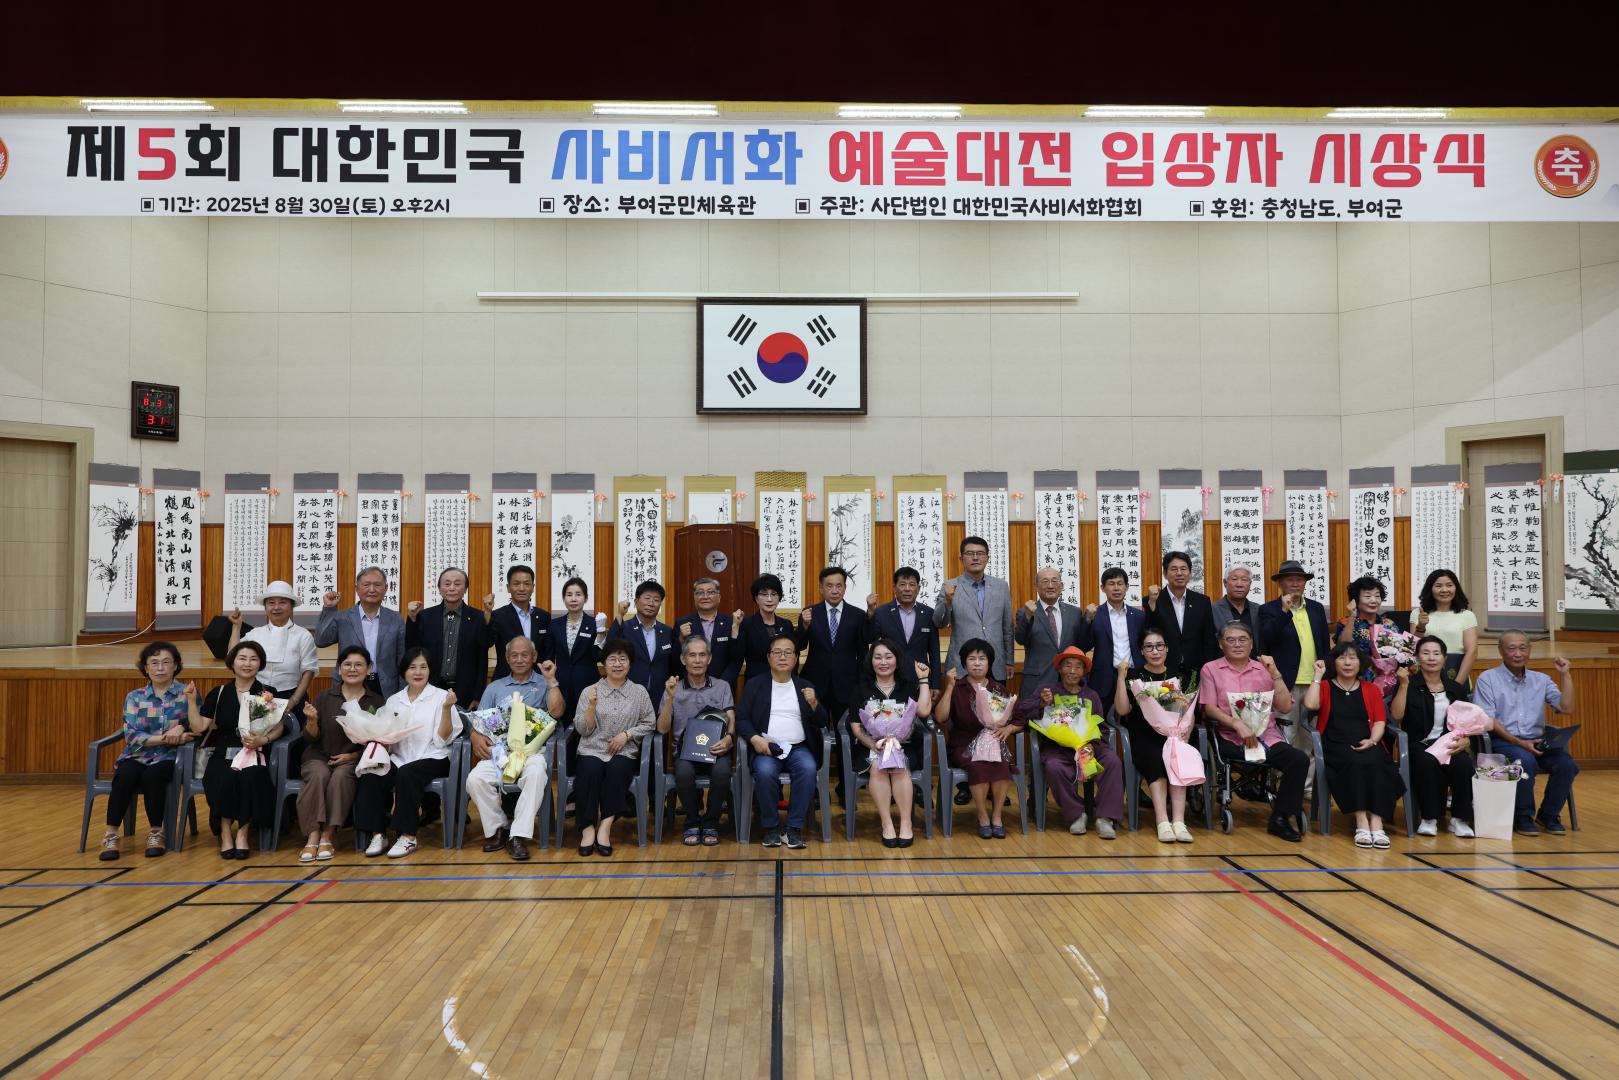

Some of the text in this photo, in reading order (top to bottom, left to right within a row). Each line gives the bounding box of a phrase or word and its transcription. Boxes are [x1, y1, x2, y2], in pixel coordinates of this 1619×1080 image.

[66, 123, 1486, 188] 제5회 대한민국 사비서화 예술대전 입상자 시상식
[1551, 147, 1584, 185] 축
[158, 196, 451, 215] 기간: 2025년 8월 30일(토) 오후2시
[563, 194, 757, 216] 장소: 부여군민체육관
[819, 196, 1142, 217] 주관: 사단법인 대한민국사비서화협회
[1210, 197, 1254, 219] 후원:
[1346, 198, 1403, 219] 부여군
